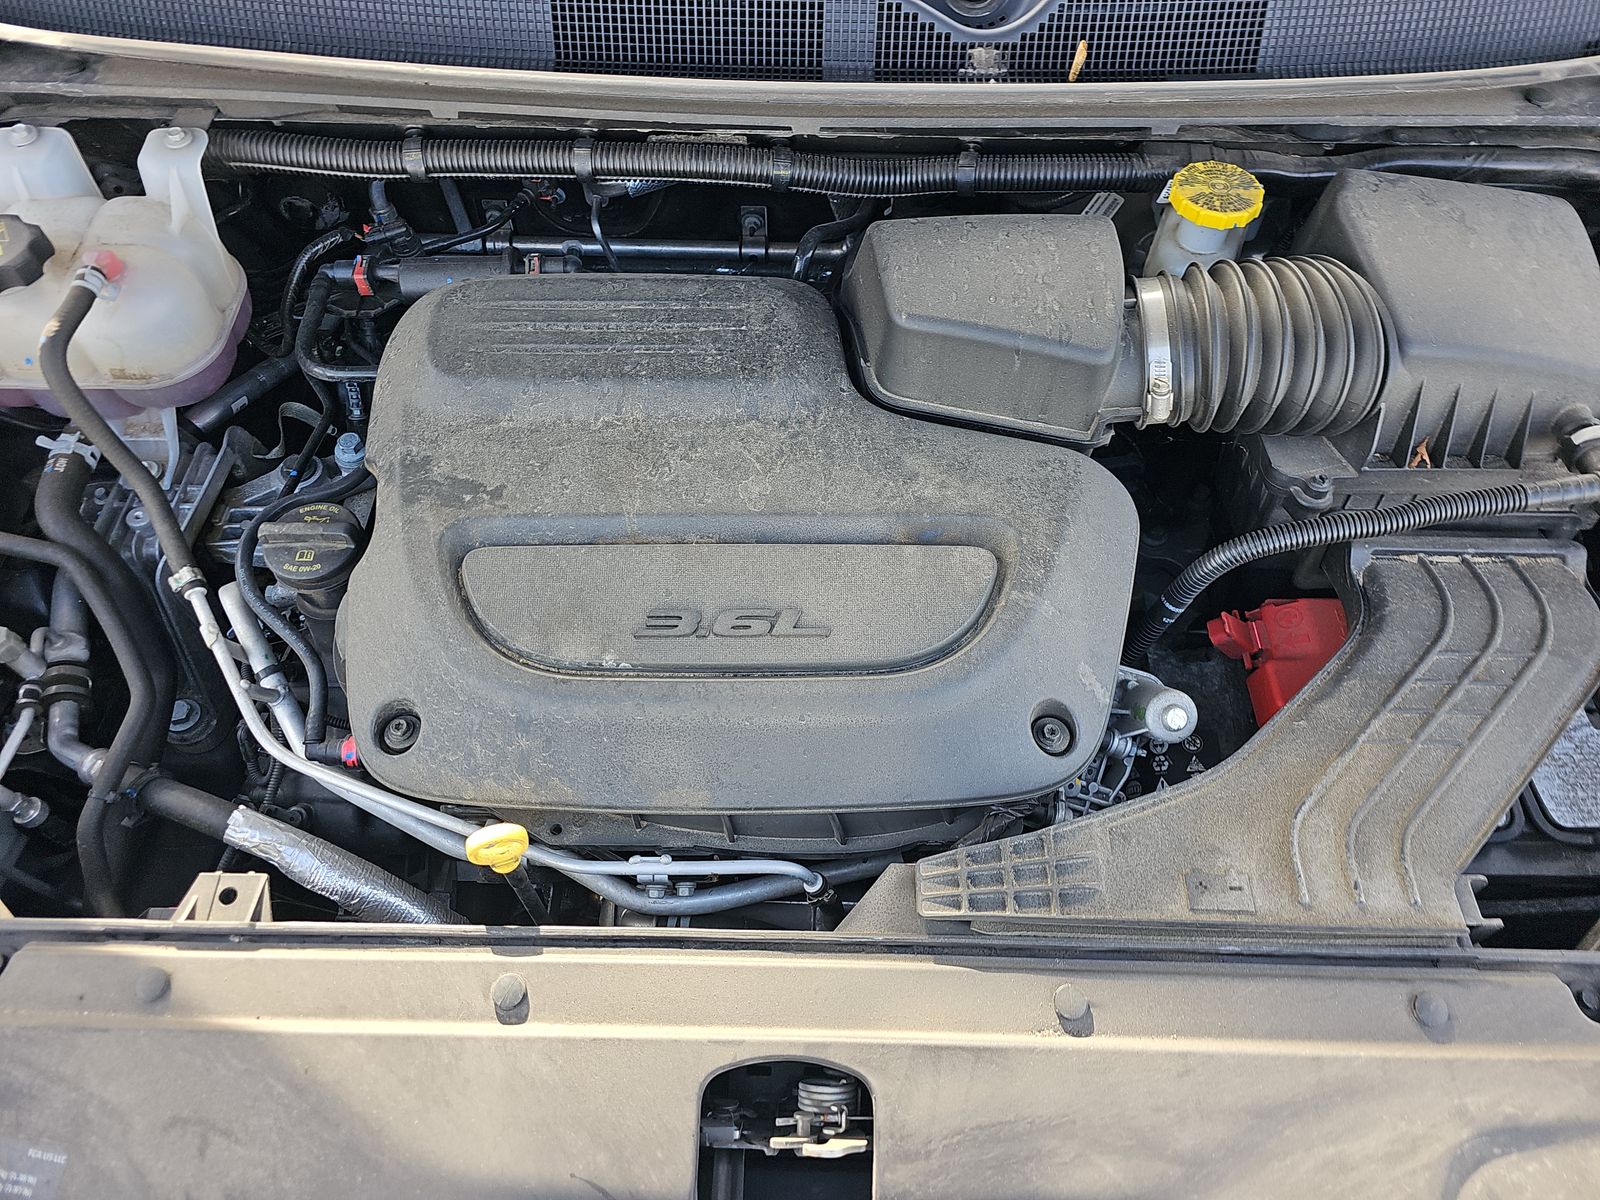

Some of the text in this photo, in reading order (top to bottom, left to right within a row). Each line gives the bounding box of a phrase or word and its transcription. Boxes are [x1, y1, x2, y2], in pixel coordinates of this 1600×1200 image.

[299, 504, 341, 514] ENGINE OIL
[283, 563, 321, 572] SAE 0W-20
[634, 607, 831, 638] 3.6L
